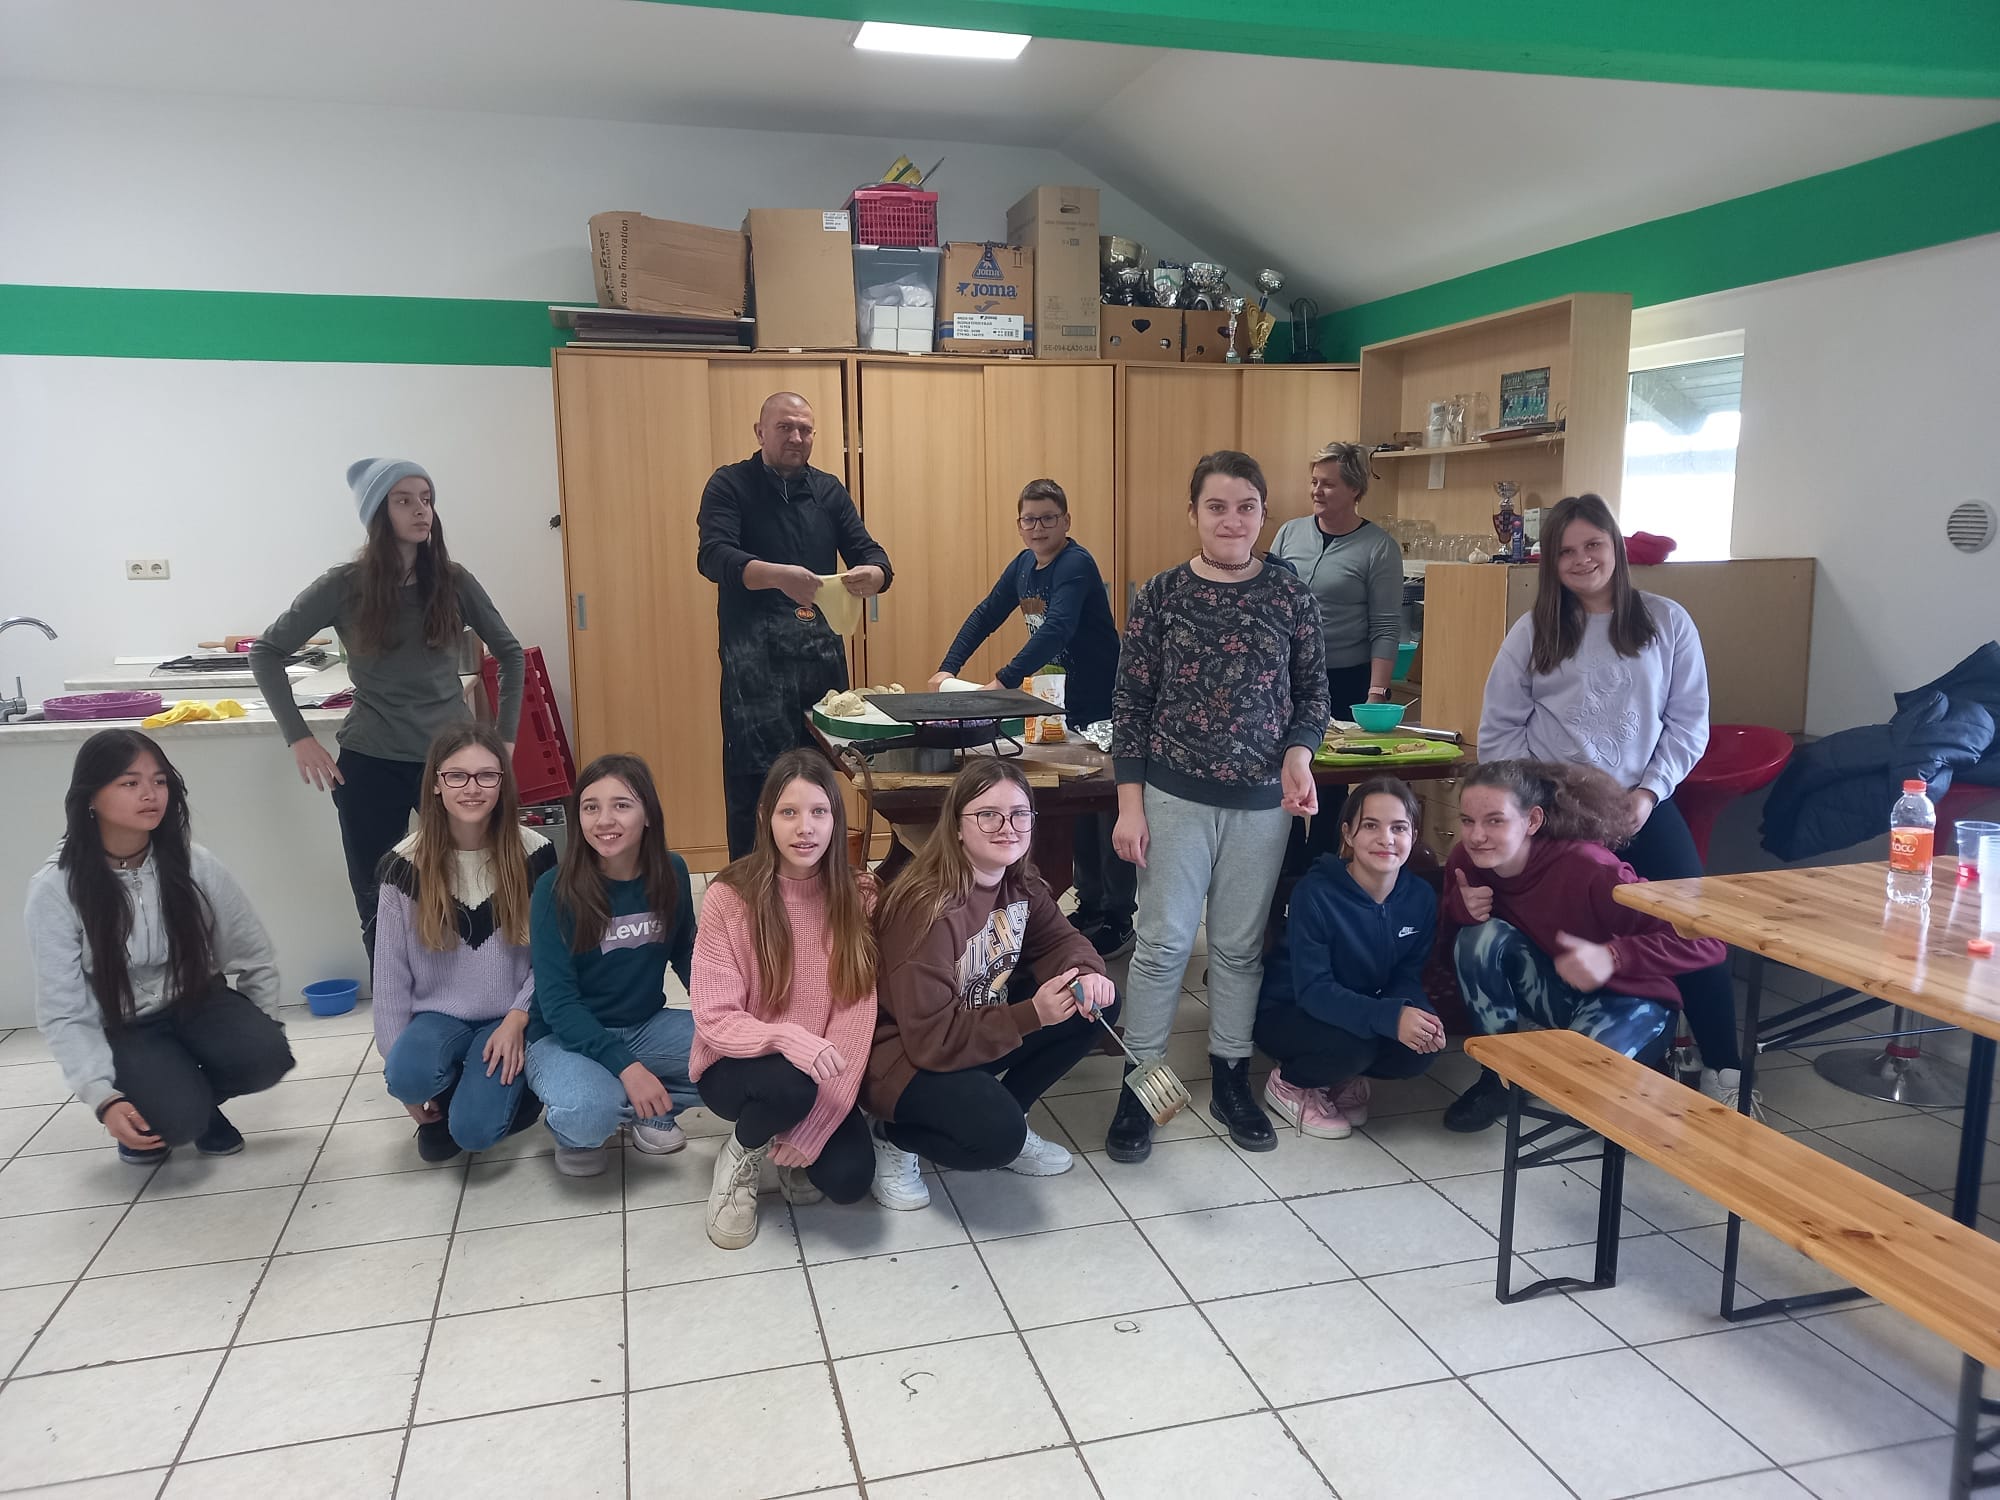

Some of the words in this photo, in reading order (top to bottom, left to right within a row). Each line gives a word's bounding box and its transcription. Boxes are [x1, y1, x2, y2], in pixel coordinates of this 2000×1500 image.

[618, 219, 629, 270] innovation
[620, 272, 628, 289] the
[621, 291, 628, 303] do
[971, 283, 1018, 298] Joma
